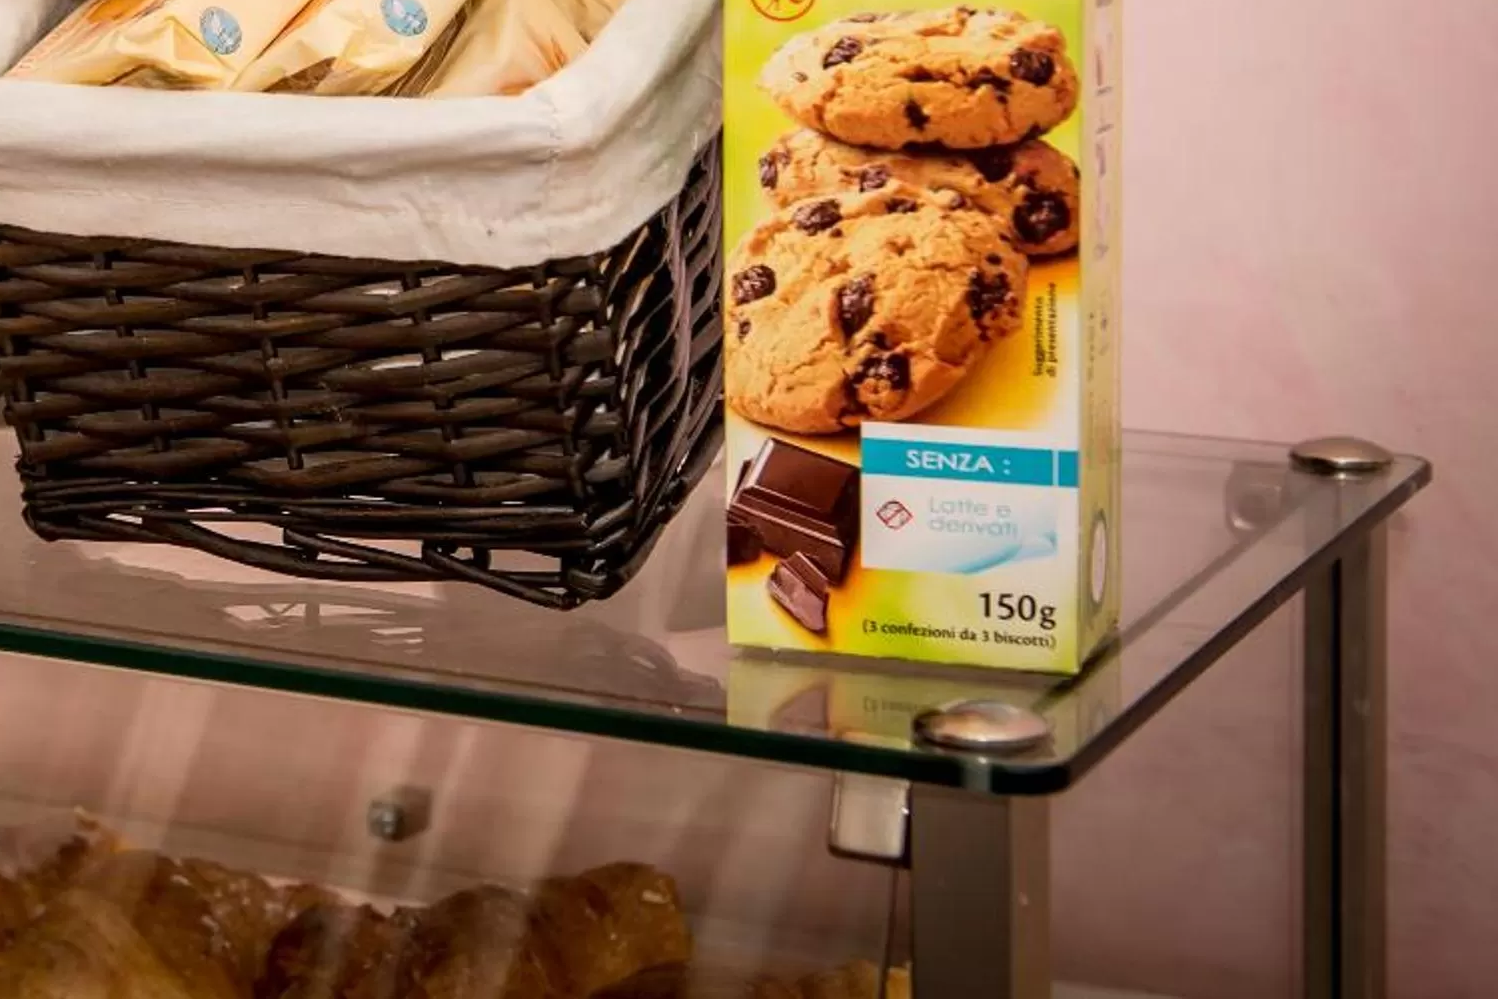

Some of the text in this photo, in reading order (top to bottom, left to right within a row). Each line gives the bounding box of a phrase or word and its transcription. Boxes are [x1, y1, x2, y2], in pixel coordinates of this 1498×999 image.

[906, 450, 994, 474] SENZA
[979, 592, 1057, 631] 150g
[881, 622, 955, 640] confezioni
[960, 629, 977, 641] da
[982, 631, 989, 642] 3
